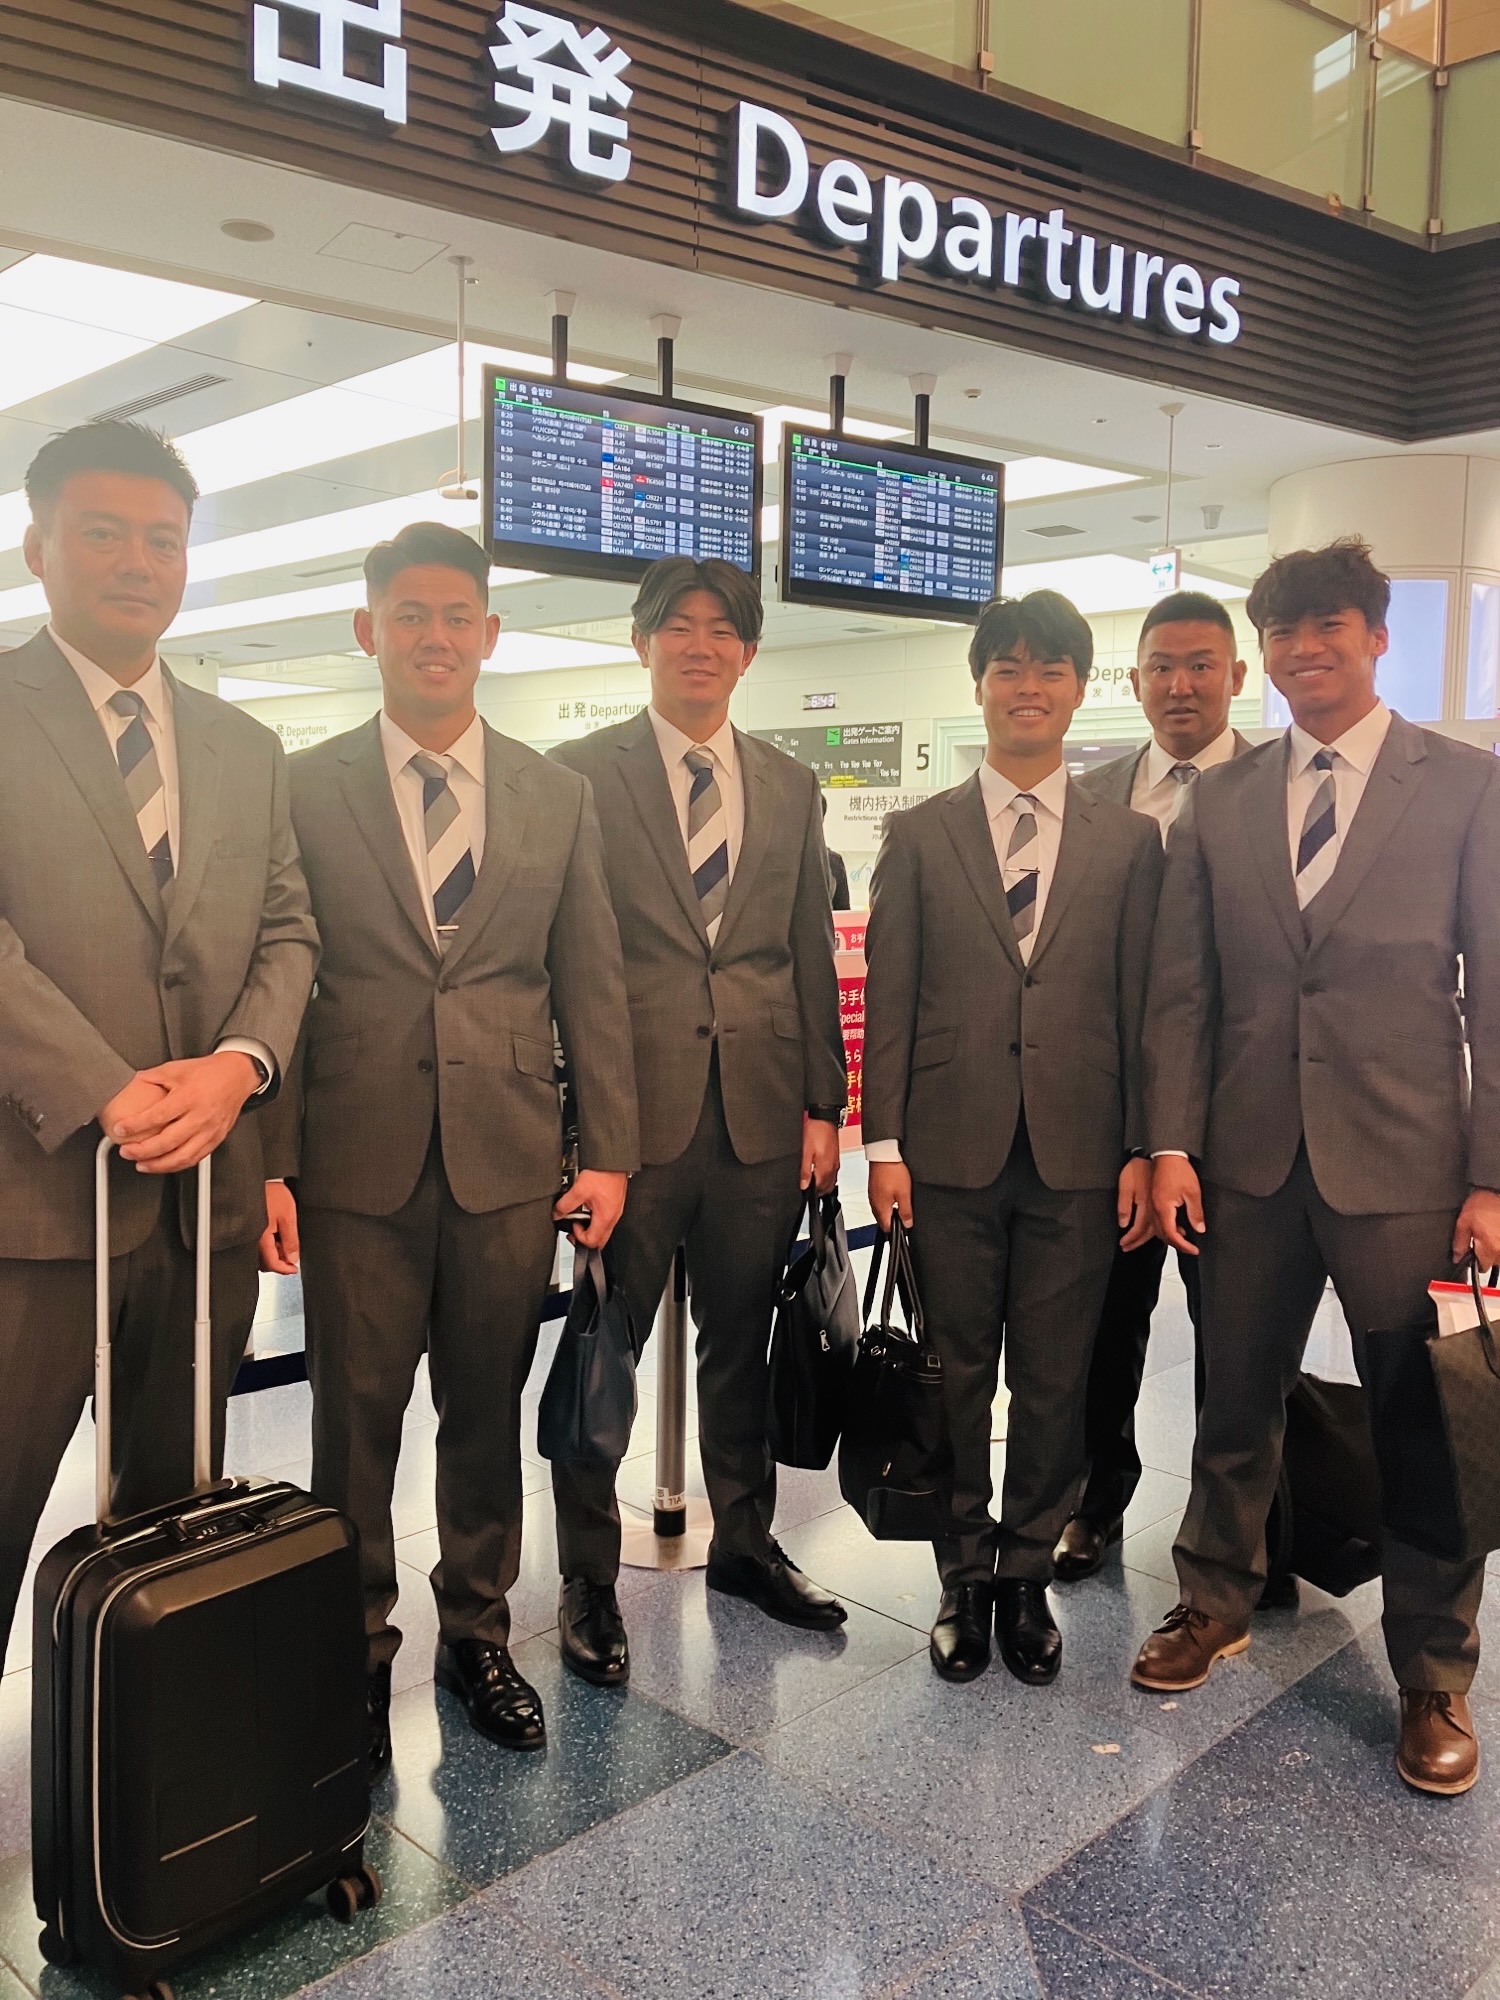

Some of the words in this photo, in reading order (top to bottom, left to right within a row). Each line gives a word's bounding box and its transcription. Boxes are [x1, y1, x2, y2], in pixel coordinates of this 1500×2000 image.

[253, 0, 632, 182] 出発
[734, 101, 1242, 344] Departures
[501, 411, 513, 419] 8:20
[811, 695, 834, 707] 6:43
[559, 702, 586, 719] 出発
[287, 725, 327, 739] Departures
[843, 725, 899, 736] 出発ゲートご案内
[860, 736, 895, 744] Information
[917, 744, 929, 770] 5
[840, 1010, 864, 1026] pecial
